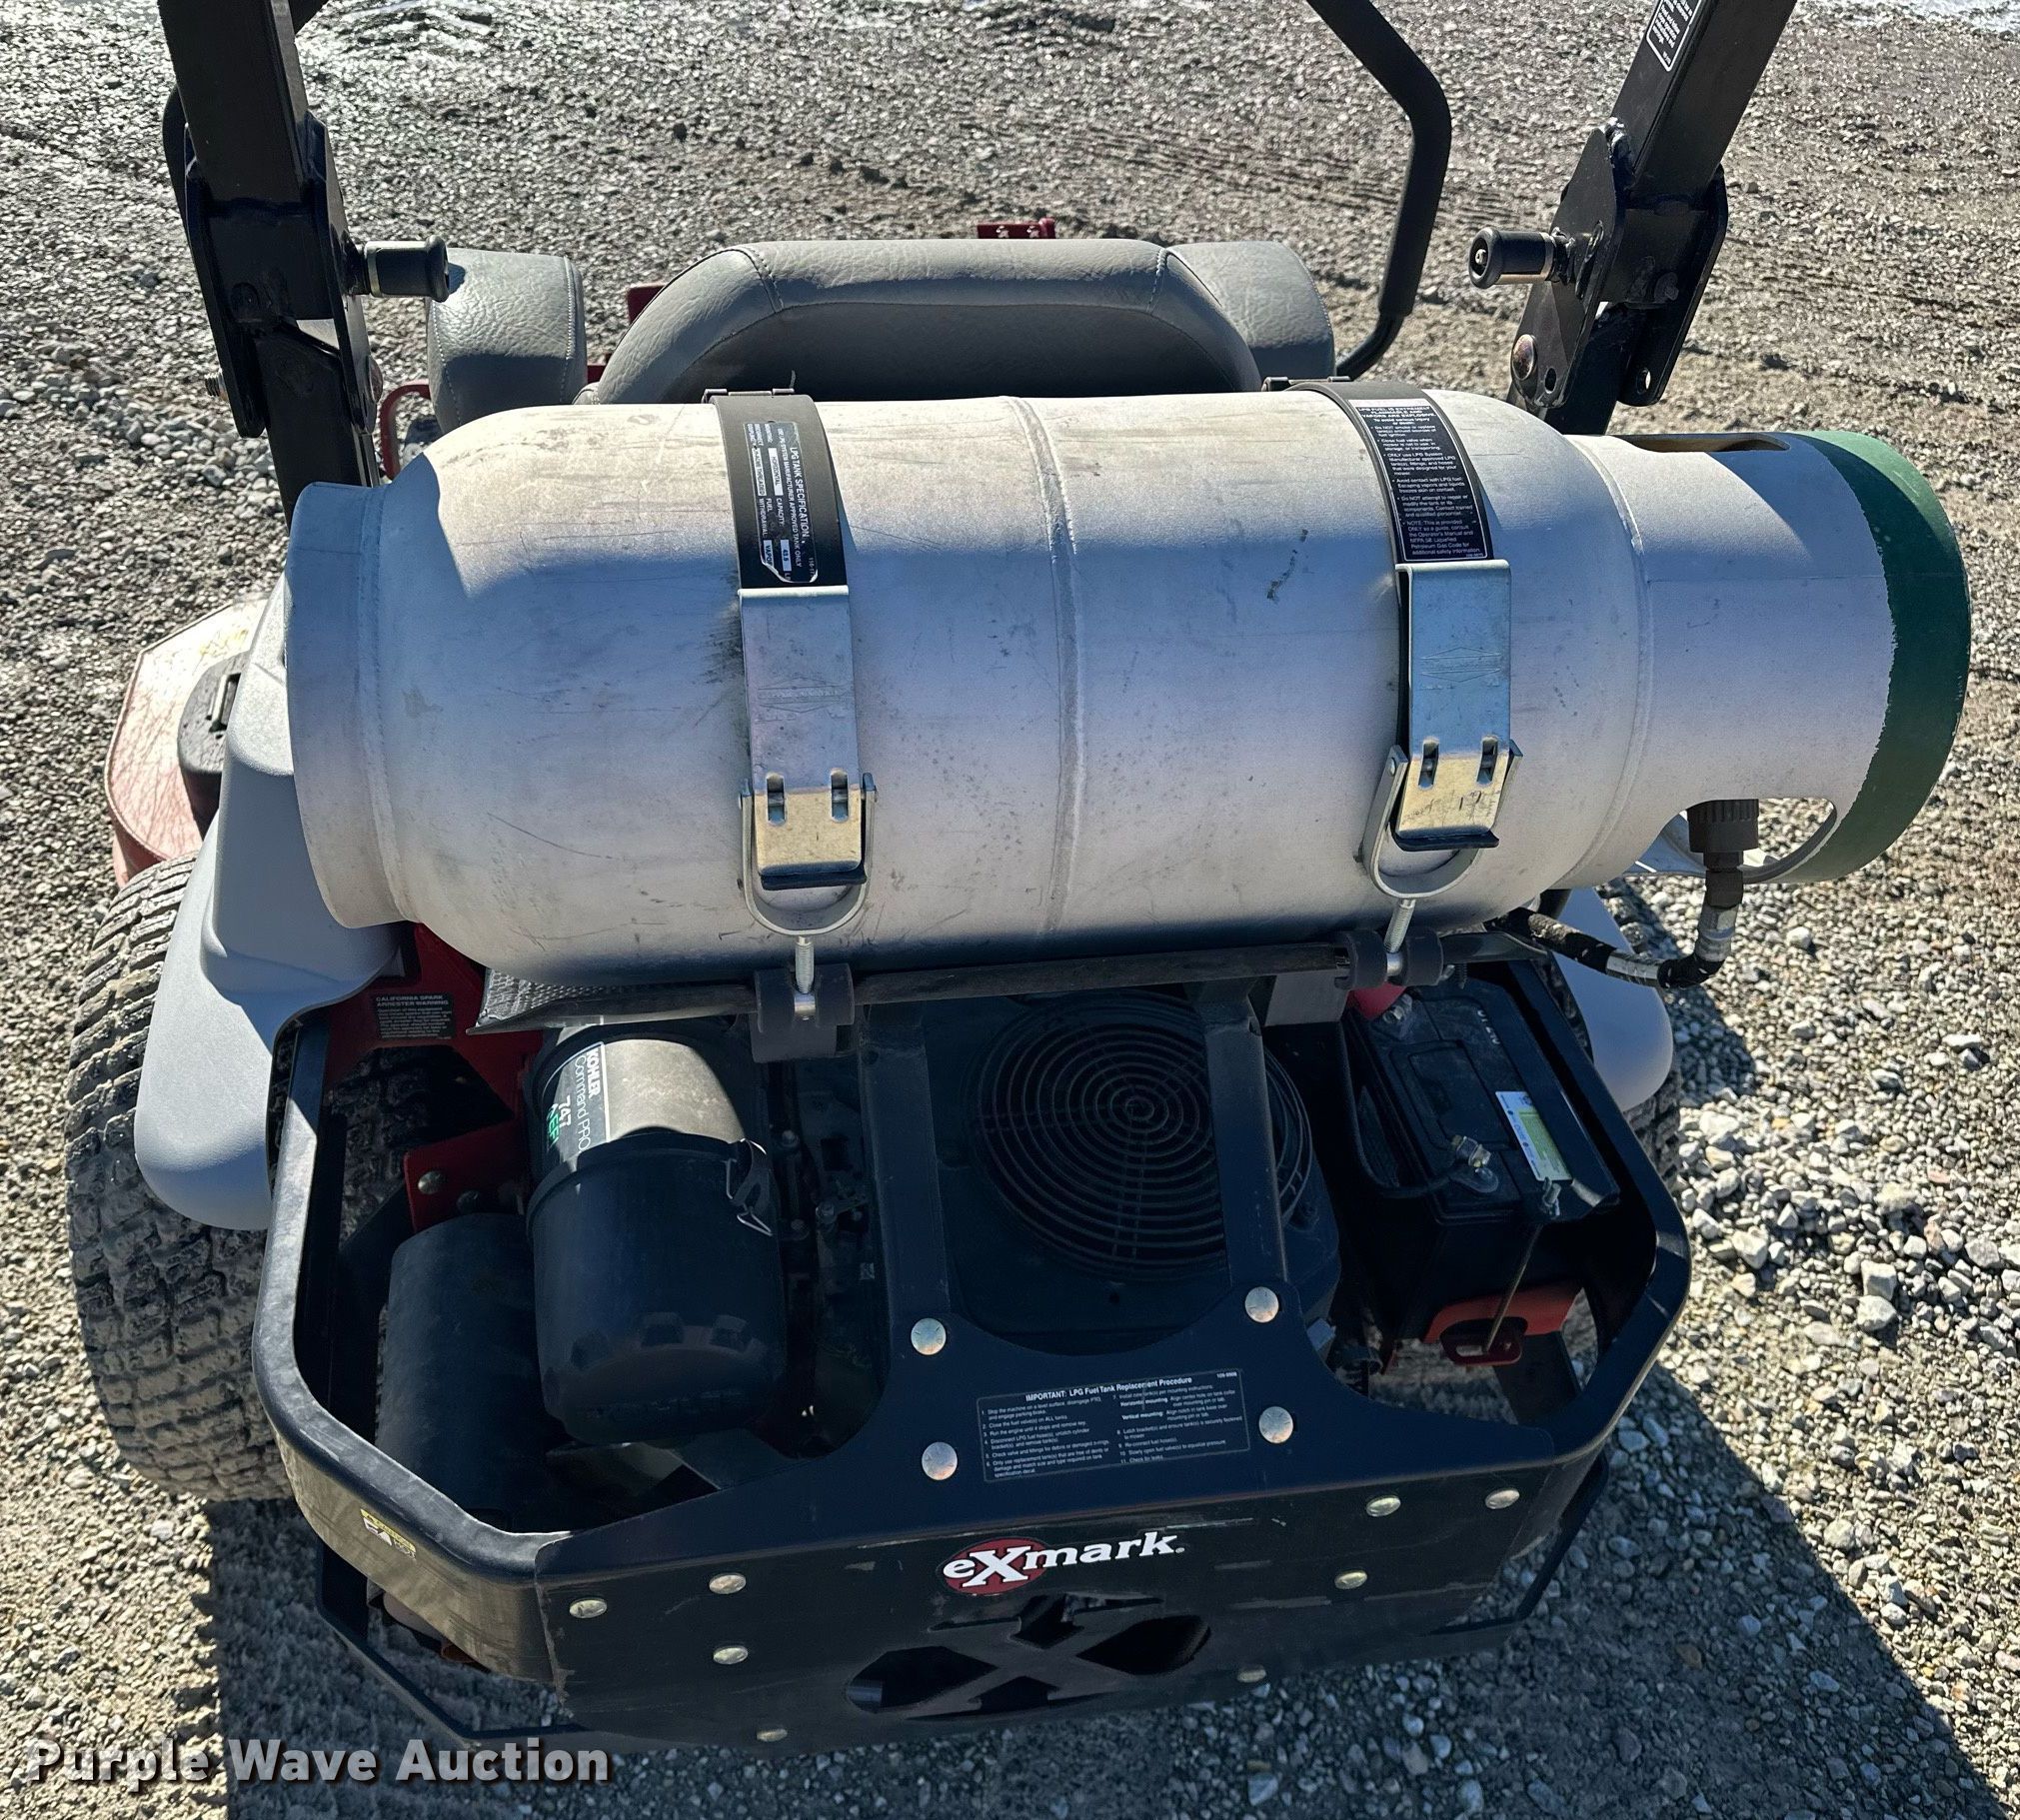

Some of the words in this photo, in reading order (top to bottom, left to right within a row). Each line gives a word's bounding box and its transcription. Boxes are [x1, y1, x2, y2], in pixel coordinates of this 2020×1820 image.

[790, 447, 799, 460] LPG
[792, 460, 803, 478] TANK
[771, 457, 781, 486] HORIZONTAL
[784, 462, 795, 502] MANUFACTURER
[789, 503, 799, 533] APPROVED
[795, 479, 811, 538] SPECIFICATION
[575, 1055, 589, 1119] Command
[587, 1047, 601, 1098] KOHLER
[559, 1094, 571, 1128] 747
[578, 1118, 591, 1150] PRO
[1026, 1390, 1067, 1401] IMPORTANT:
[1159, 1376, 1192, 1386] Procedure
[943, 1531, 1179, 1588] eXmark
